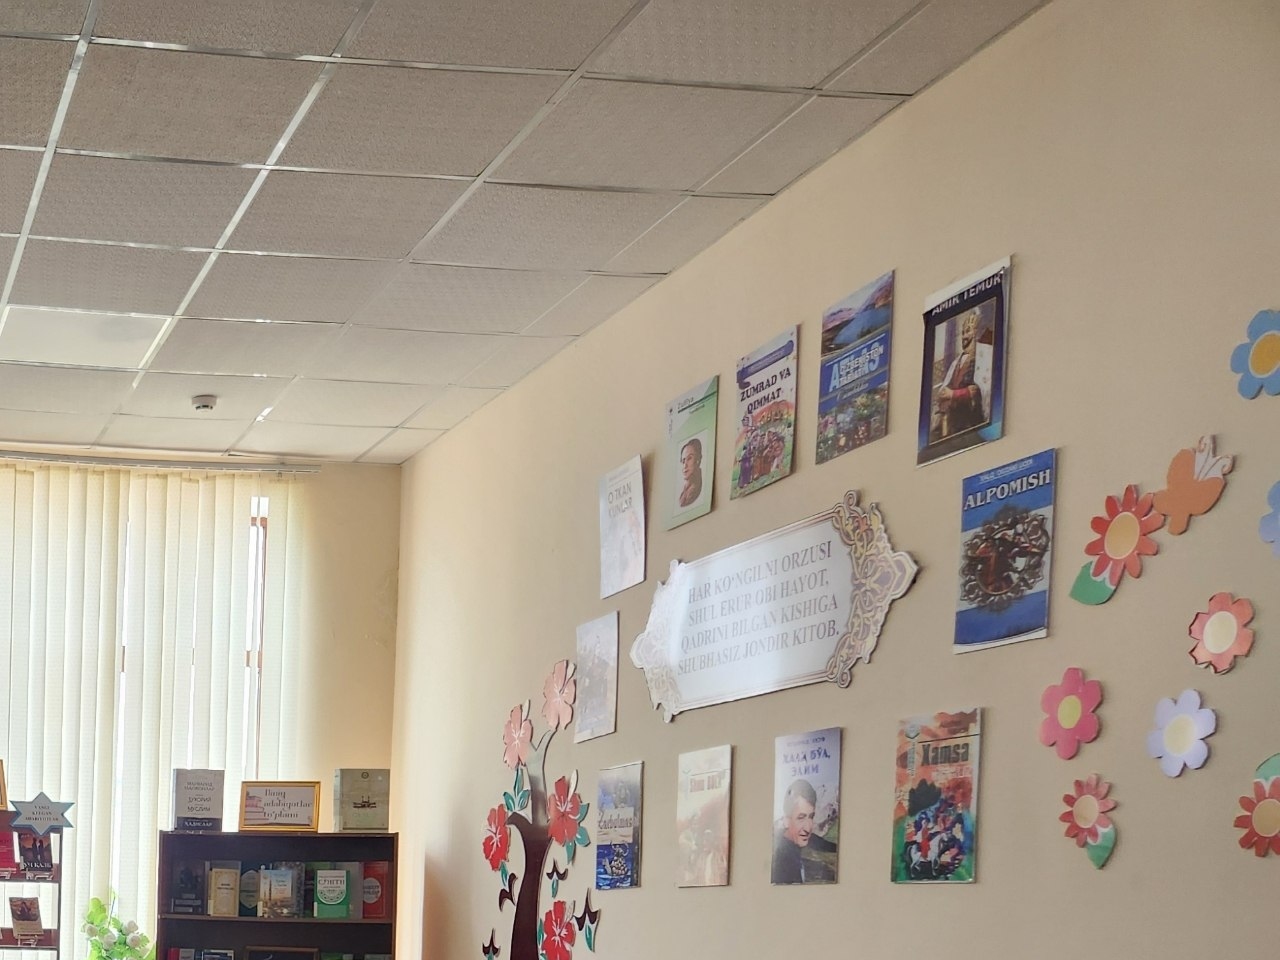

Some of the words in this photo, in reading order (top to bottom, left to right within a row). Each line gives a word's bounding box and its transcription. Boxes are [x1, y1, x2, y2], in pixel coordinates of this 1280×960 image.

[740, 374, 778, 402] ZUMRAD
[779, 367, 792, 381] VA
[747, 388, 782, 415] QIMMAT
[963, 469, 1051, 511] ALPOMISH
[688, 582, 716, 604] HAR
[781, 540, 832, 573] ORZUSI
[680, 626, 729, 654] QADRINI
[731, 609, 778, 638] BILGAN
[780, 593, 838, 624] KISHIGA
[688, 604, 718, 627] SHUL
[720, 592, 753, 618] ERUR
[755, 584, 778, 606] OBI
[677, 647, 742, 676] SHUBHASIZ
[743, 631, 789, 660] JONDIR
[792, 619, 840, 647] KITOB.
[920, 742, 970, 767] Xamsa
